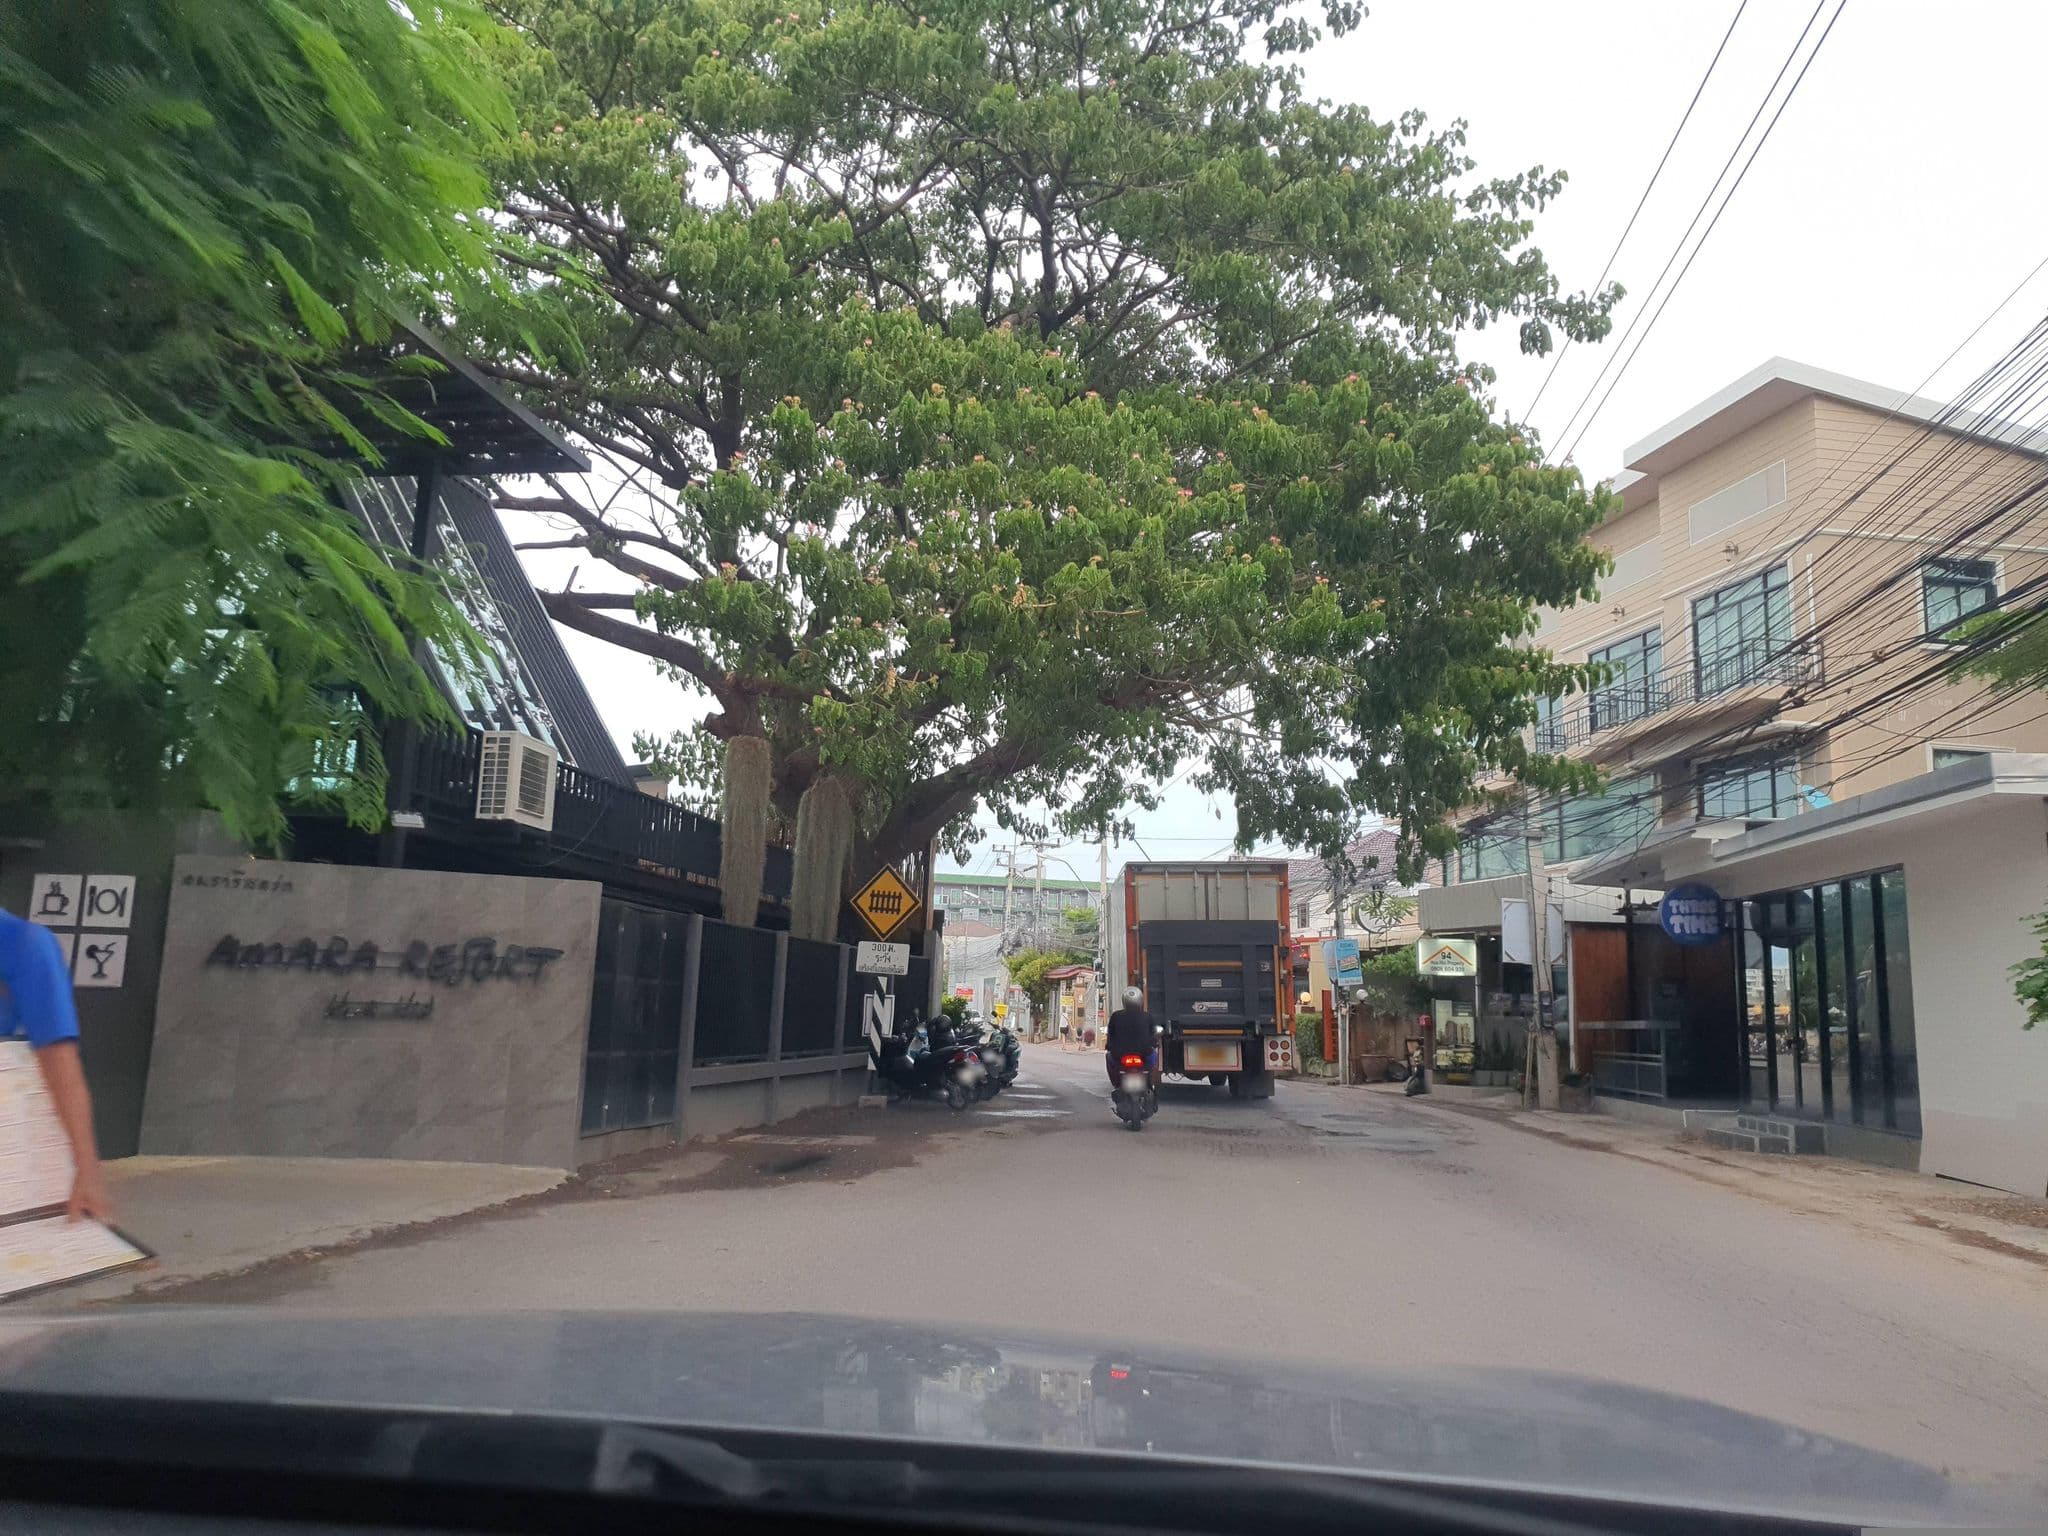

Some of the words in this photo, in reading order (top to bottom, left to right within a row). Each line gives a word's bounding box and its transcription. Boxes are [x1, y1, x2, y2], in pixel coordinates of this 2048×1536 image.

[1669, 914, 1719, 934] TIME
[871, 943, 887, 953] 300
[1440, 951, 1452, 960] 94
